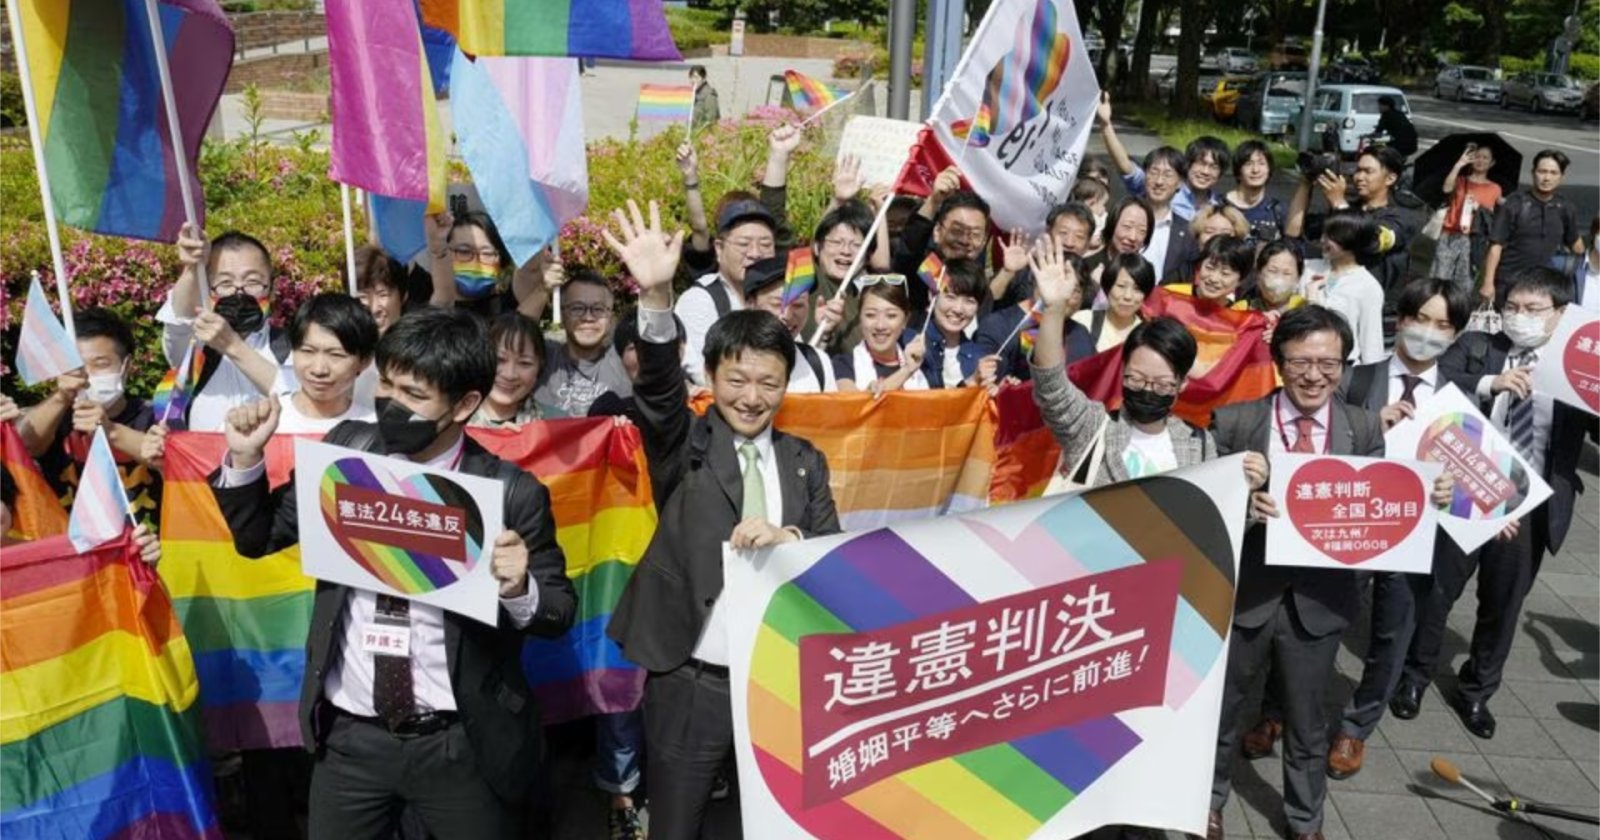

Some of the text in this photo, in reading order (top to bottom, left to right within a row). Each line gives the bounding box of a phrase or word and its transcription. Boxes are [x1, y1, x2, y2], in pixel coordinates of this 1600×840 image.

[1440, 430, 1509, 497] 憲法14条違反
[1296, 481, 1371, 500] 違憲判断
[338, 499, 462, 535] 憲法24条違反
[1332, 497, 1418, 519] 全国3例目
[1312, 526, 1369, 540] 次は九州!
[366, 634, 404, 649] 弁護士
[823, 584, 1116, 712] 違憲判決
[826, 644, 1150, 789] 婚姻平等へさらに前進!
